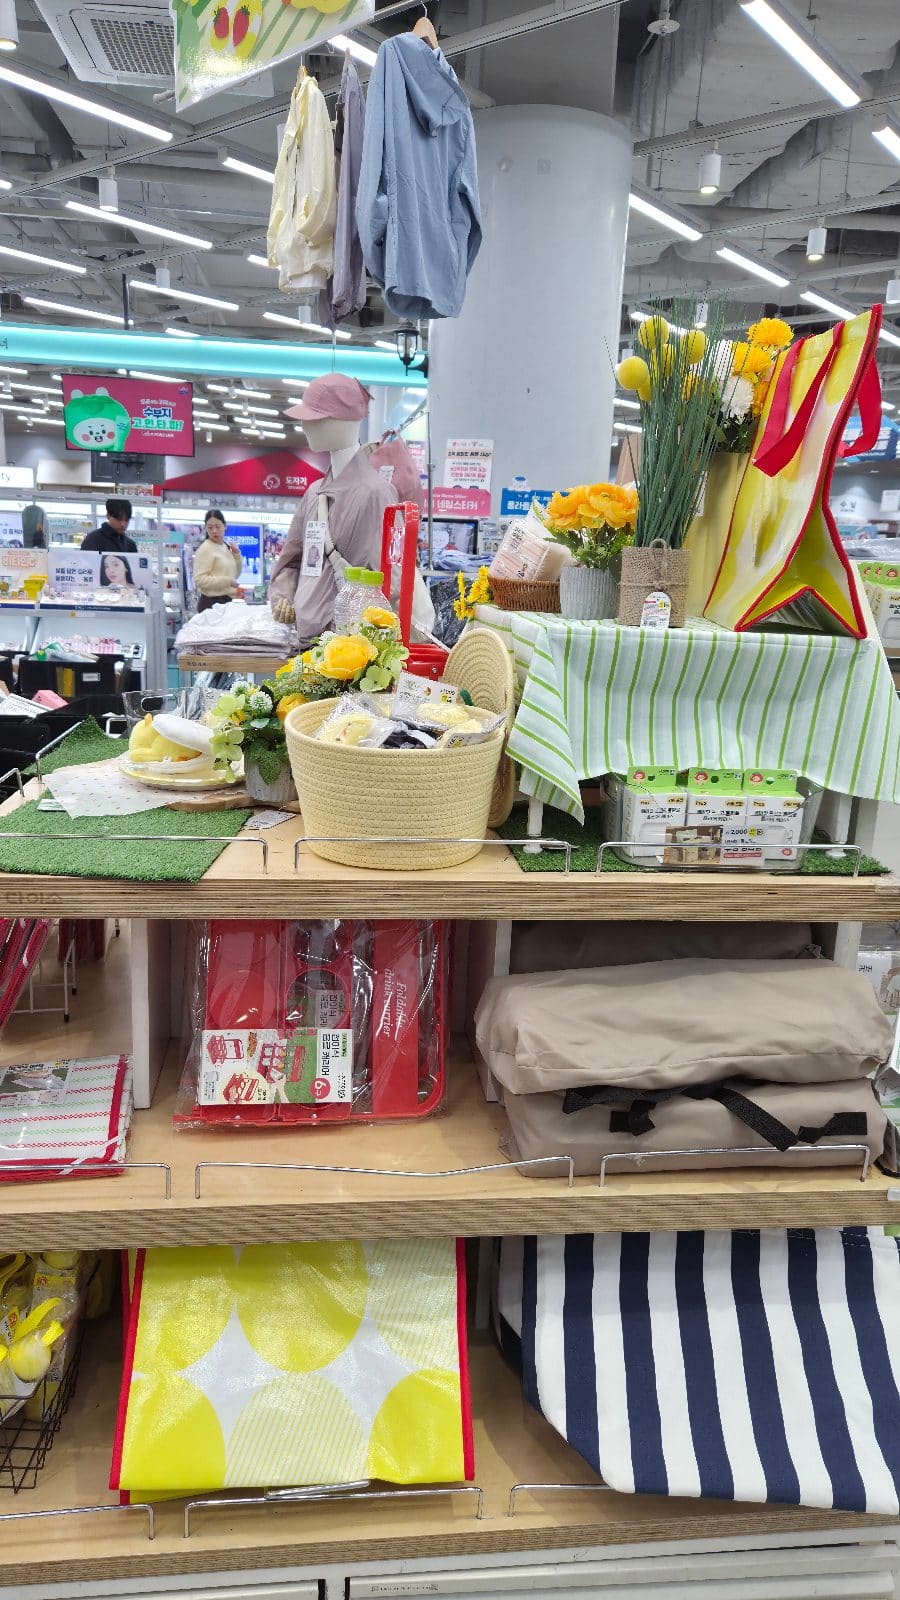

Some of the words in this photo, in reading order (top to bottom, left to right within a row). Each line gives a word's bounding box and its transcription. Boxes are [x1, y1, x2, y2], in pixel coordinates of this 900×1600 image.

[143, 406, 172, 419] 수부지
[286, 476, 307, 486] 도자기
[322, 1033, 331, 1049] 음료
[321, 1051, 330, 1076] 캐리어
